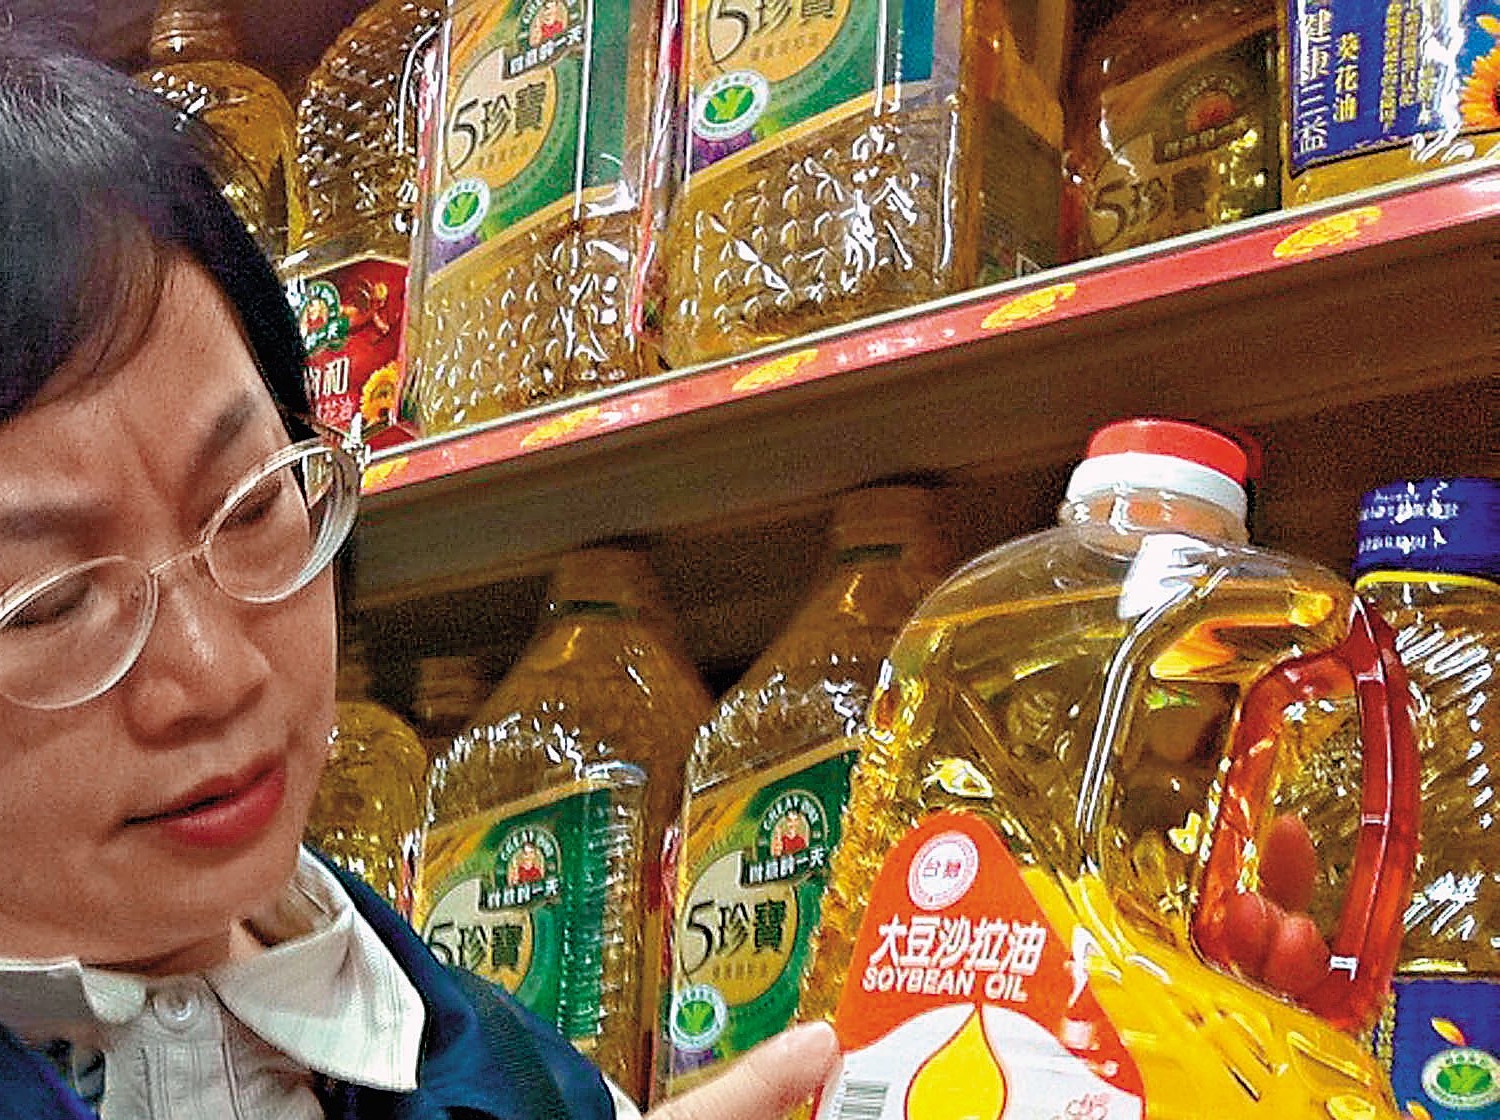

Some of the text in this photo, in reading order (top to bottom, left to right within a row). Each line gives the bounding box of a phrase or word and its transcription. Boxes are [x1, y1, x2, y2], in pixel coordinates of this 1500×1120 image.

[1333, 32, 1361, 122] 葵花油
[451, 81, 547, 175] 5珍寶
[684, 898, 787, 970] 5珍寶
[870, 913, 1047, 976] 大豆沙拉油
[862, 964, 1029, 1003] SOYBEAN OIL
